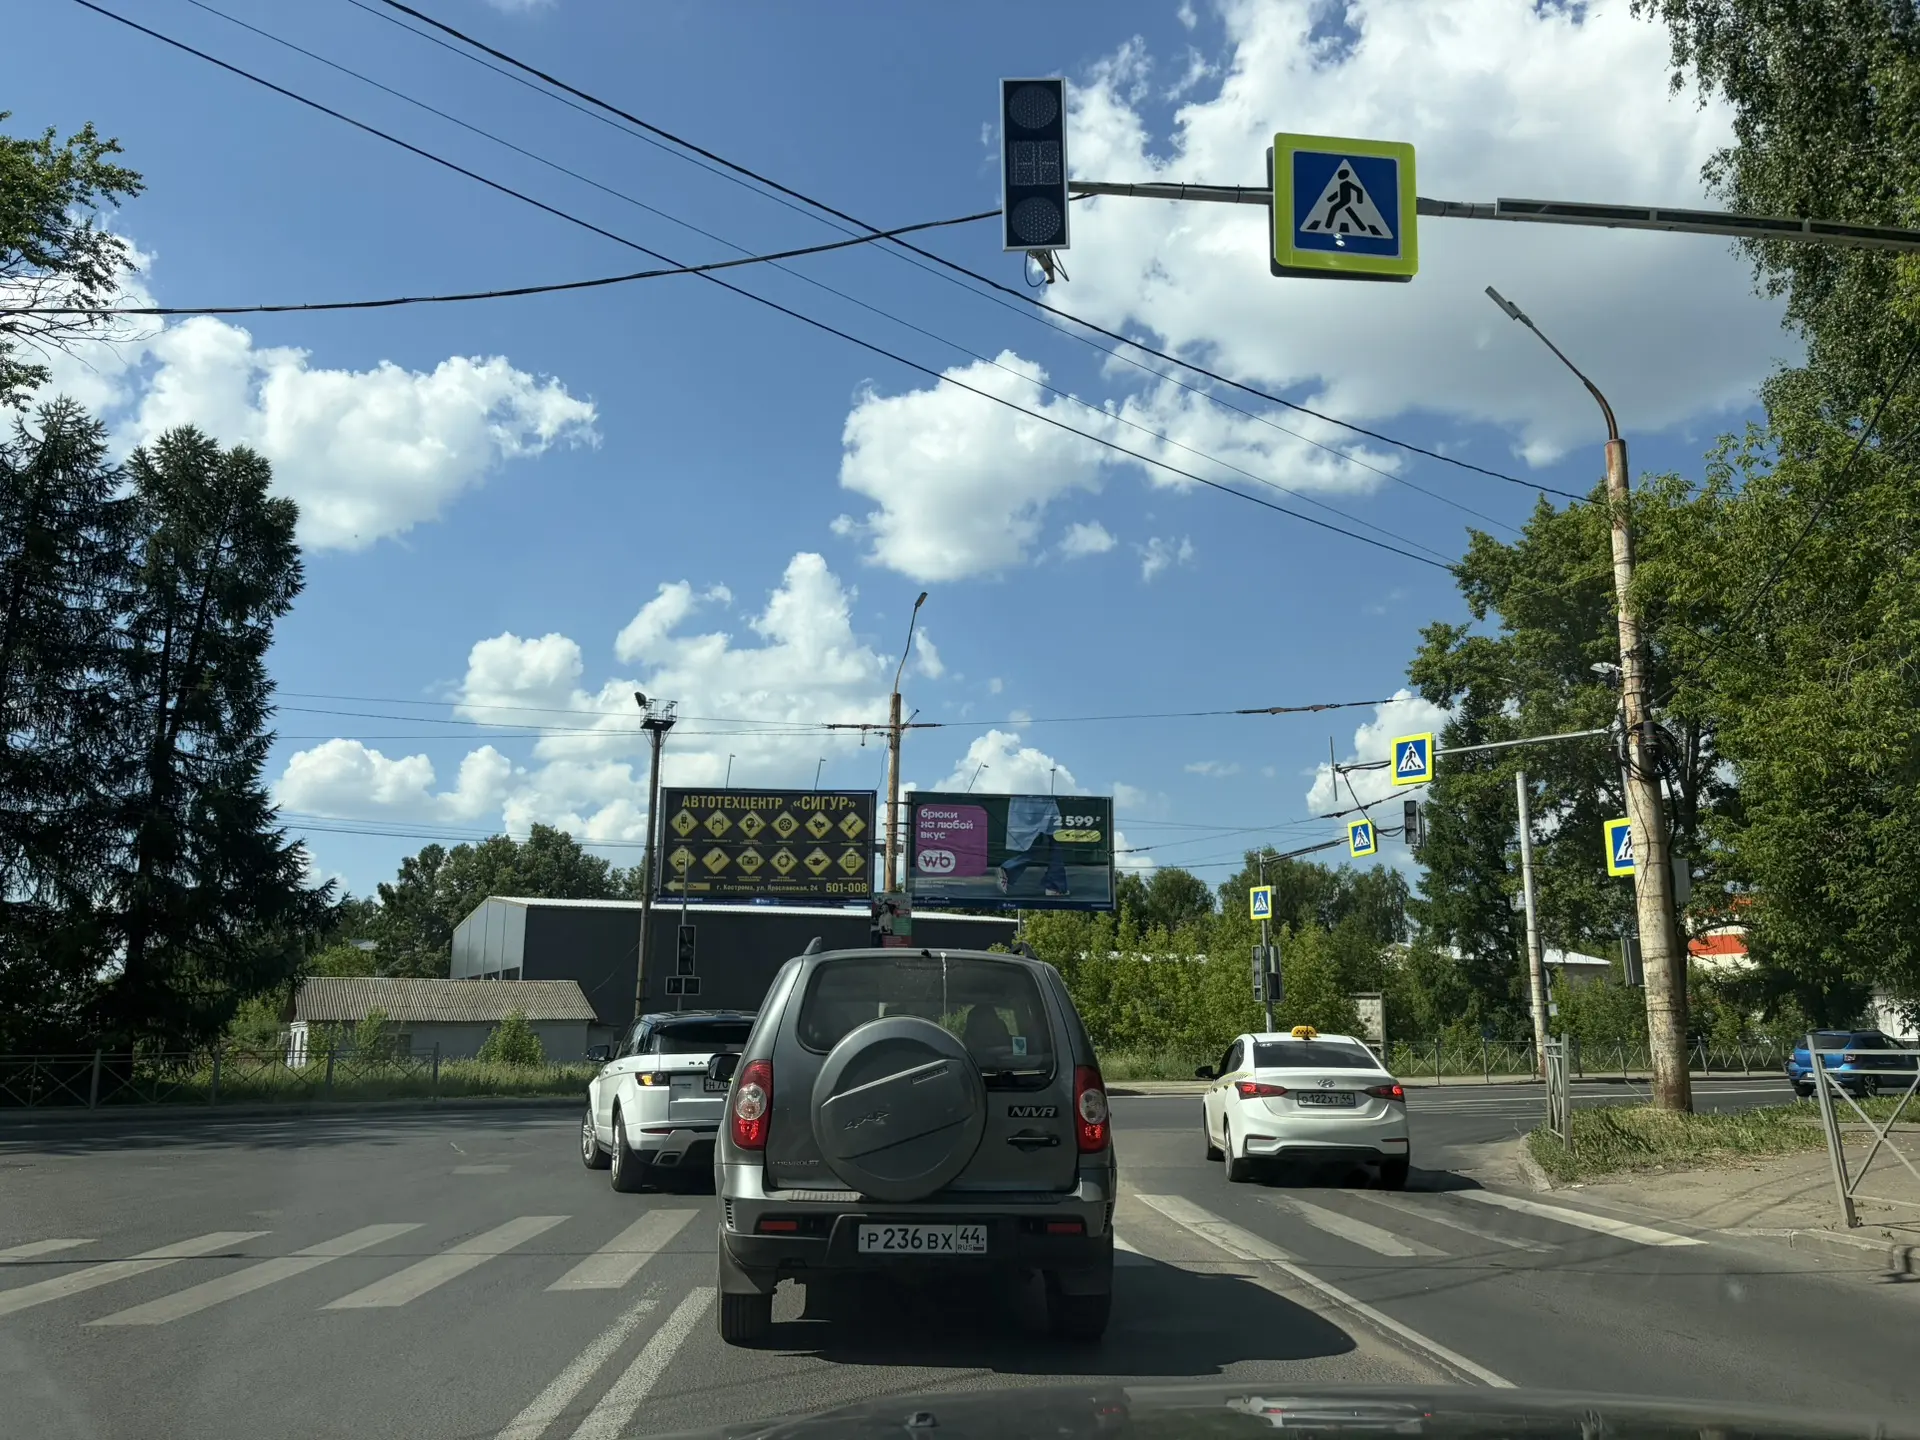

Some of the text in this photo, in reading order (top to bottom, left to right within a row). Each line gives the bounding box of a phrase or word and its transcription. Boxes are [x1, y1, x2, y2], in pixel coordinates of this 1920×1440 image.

[681, 795, 856, 811] АВТОТЕХЦЕНТР «СИГУР»
[920, 808, 958, 819] брюки
[920, 820, 974, 829] на любой
[920, 831, 946, 840] вкус
[922, 852, 951, 868] wb
[723, 884, 755, 893] Кострома,
[825, 882, 868, 893] 501-008
[1010, 1106, 1056, 1117] NIVA
